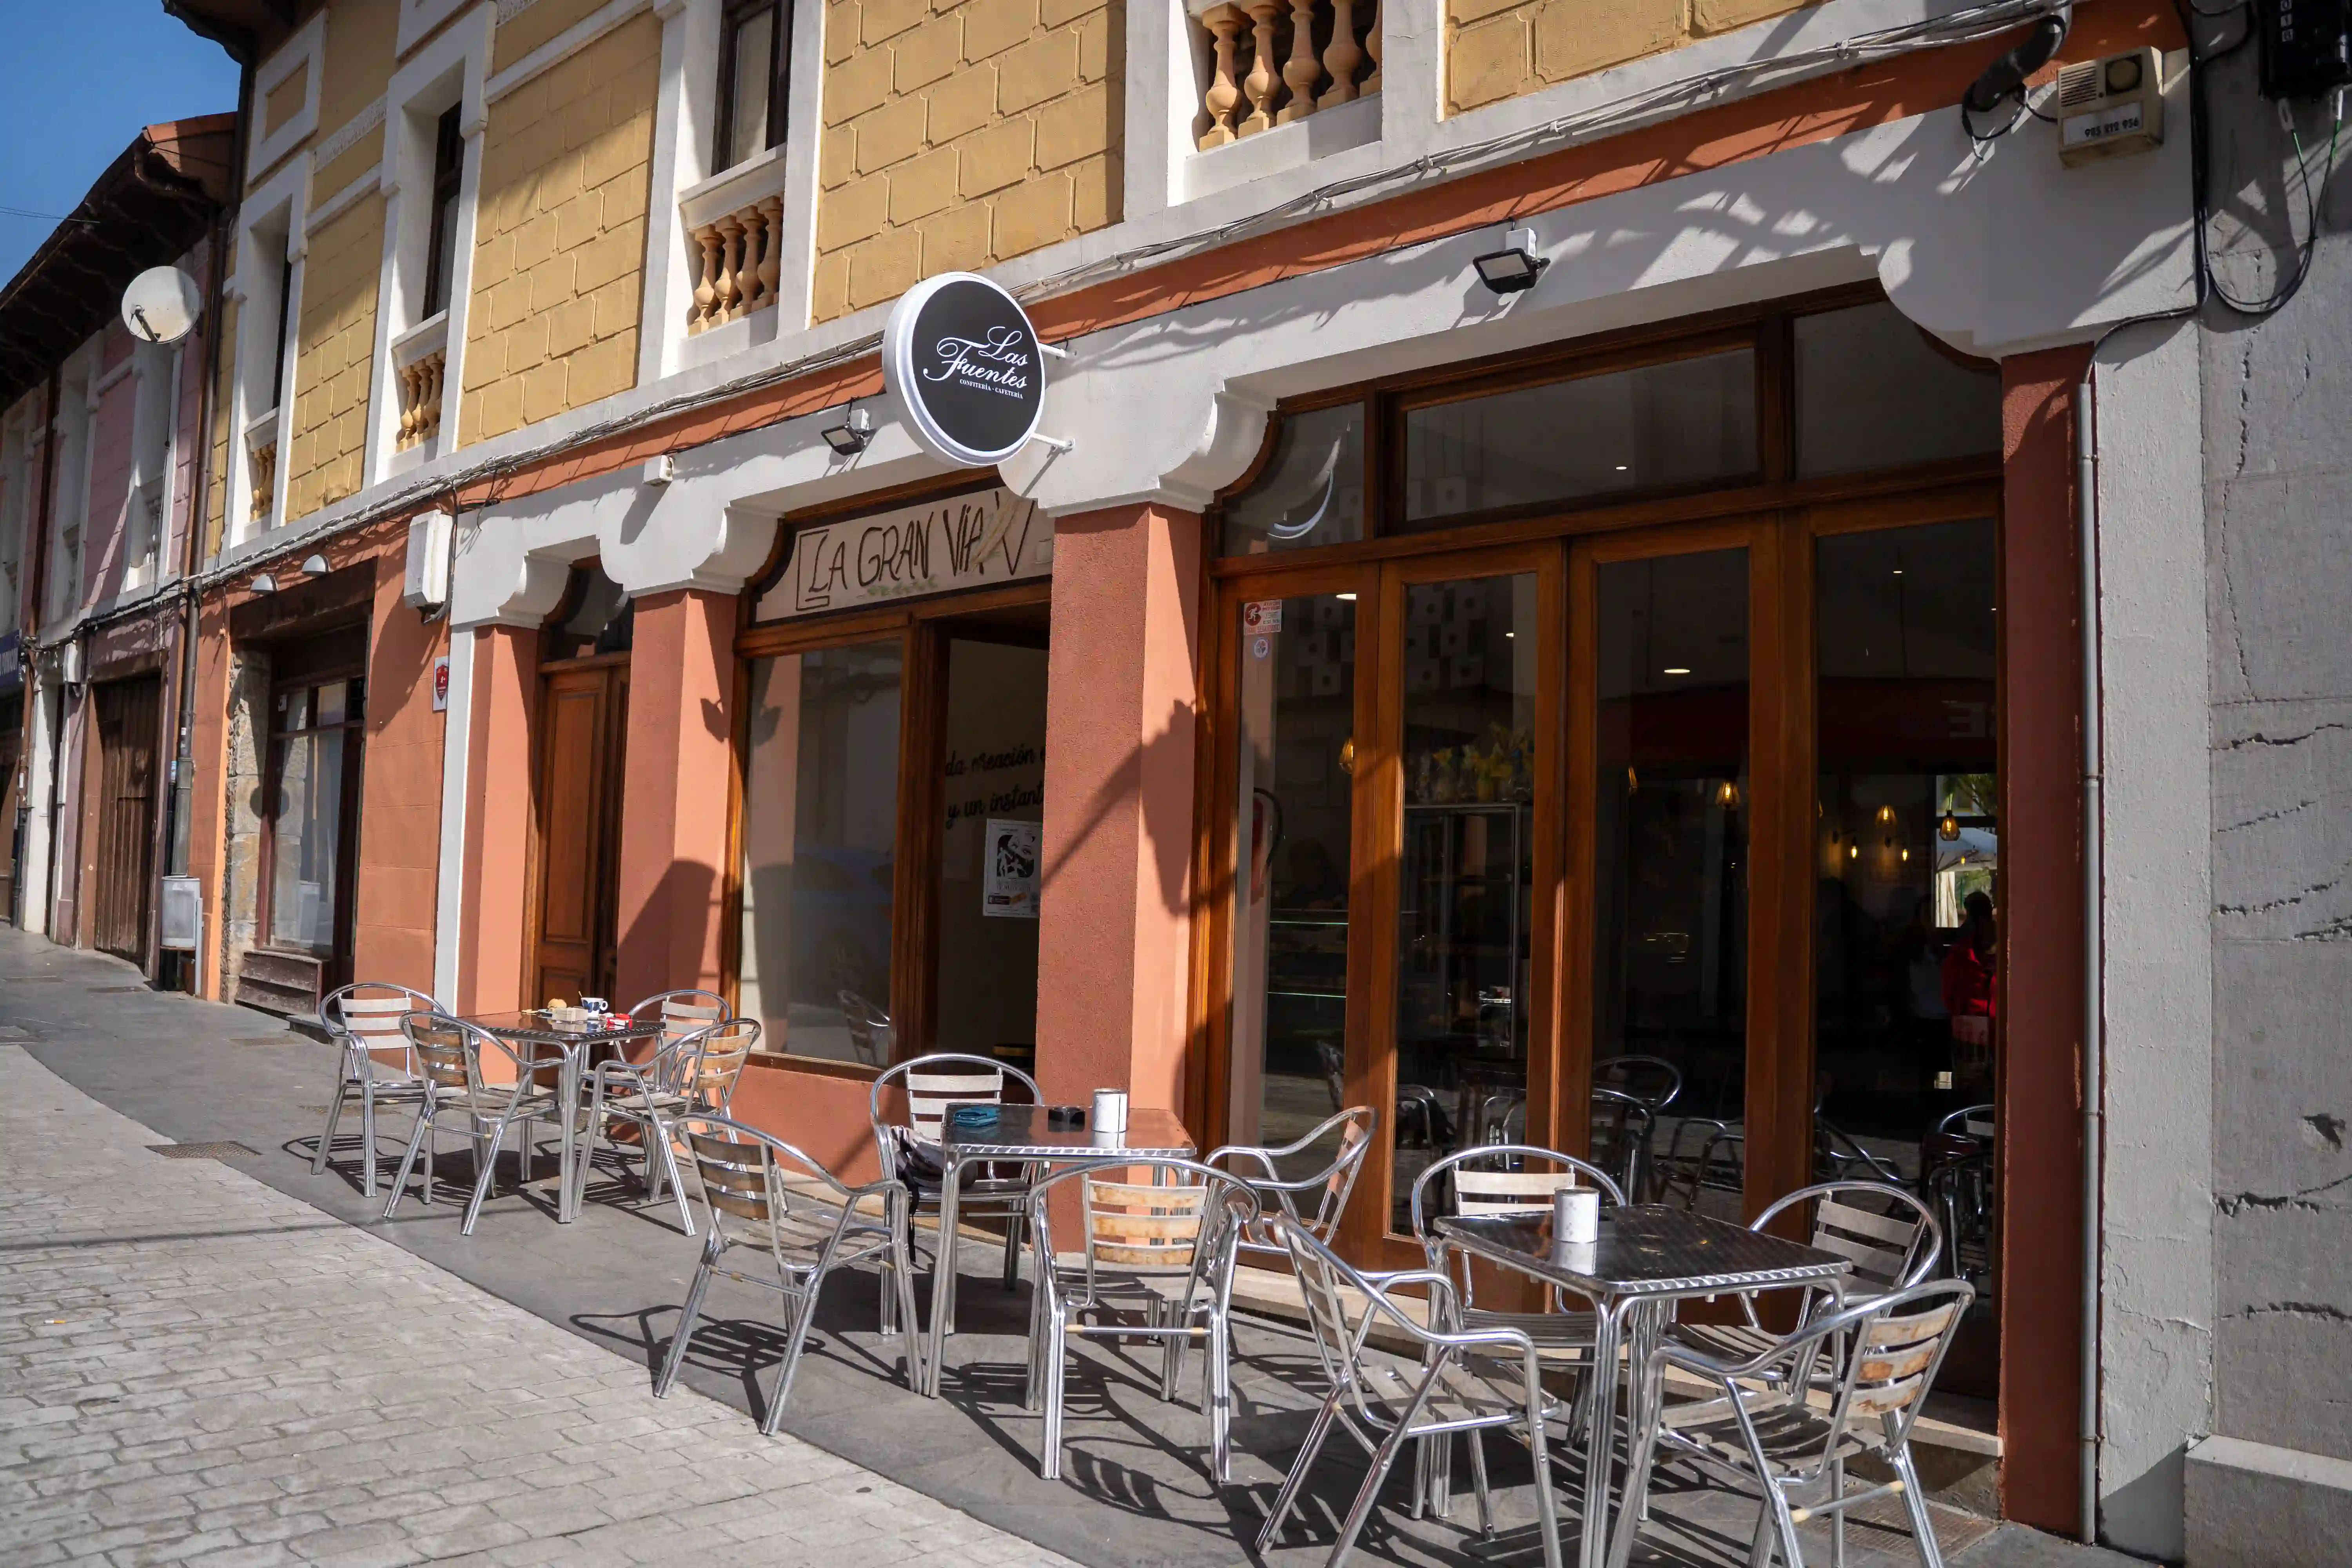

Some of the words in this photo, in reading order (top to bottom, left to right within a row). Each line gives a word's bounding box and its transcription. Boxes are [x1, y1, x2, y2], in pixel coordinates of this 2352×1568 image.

[923, 337, 1027, 388] Fuentes
[978, 326, 1027, 367] Las
[960, 378, 992, 391] CONFITERÍA
[995, 387, 1024, 399] CAFETERÍA
[808, 533, 848, 593] LA
[857, 511, 934, 587] GRAN
